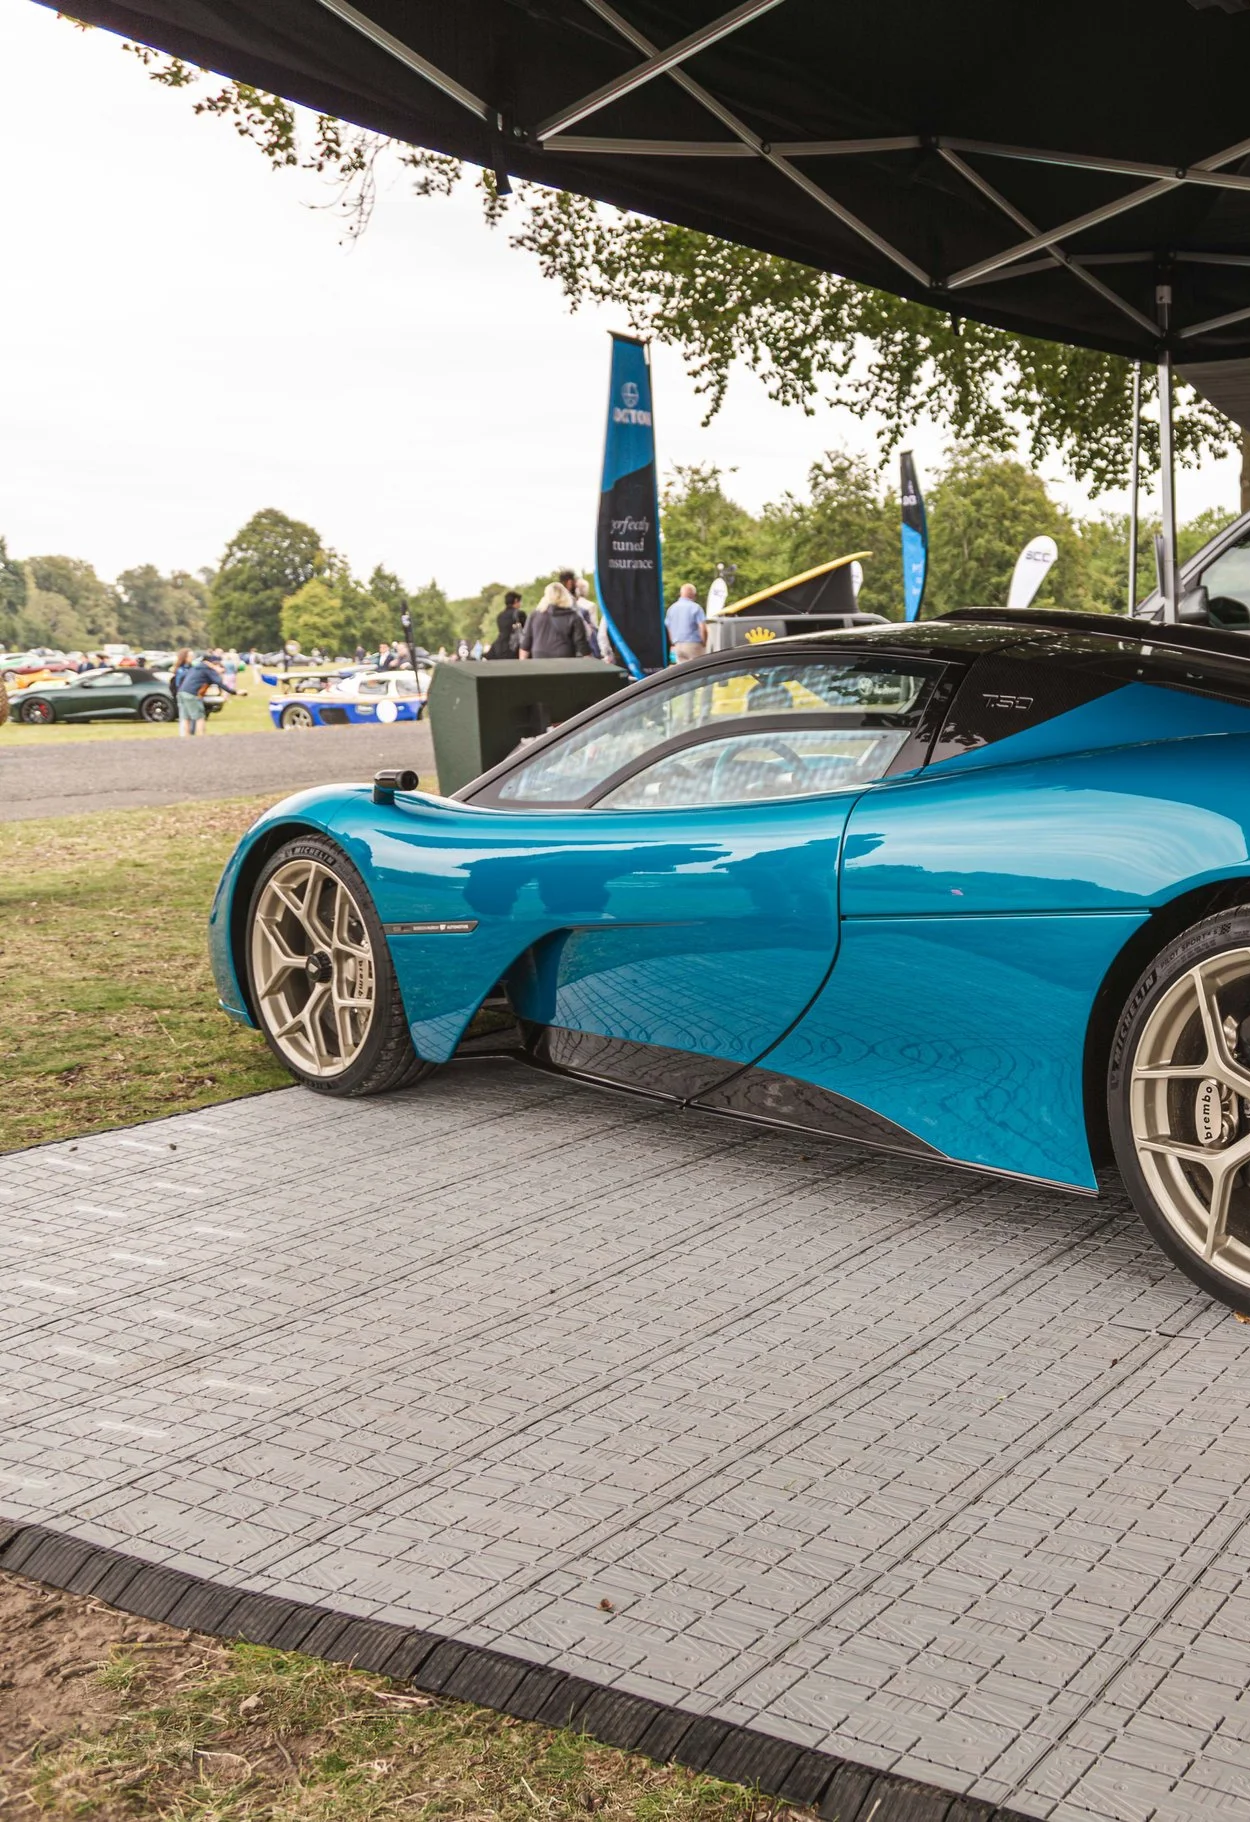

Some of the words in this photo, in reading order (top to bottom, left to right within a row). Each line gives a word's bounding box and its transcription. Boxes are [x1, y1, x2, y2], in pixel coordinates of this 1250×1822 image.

[982, 693, 1034, 711] T.50
[294, 846, 335, 866] MICHELIN
[1112, 969, 1157, 1069] MICHELIN
[1202, 1086, 1213, 1140] brembo
